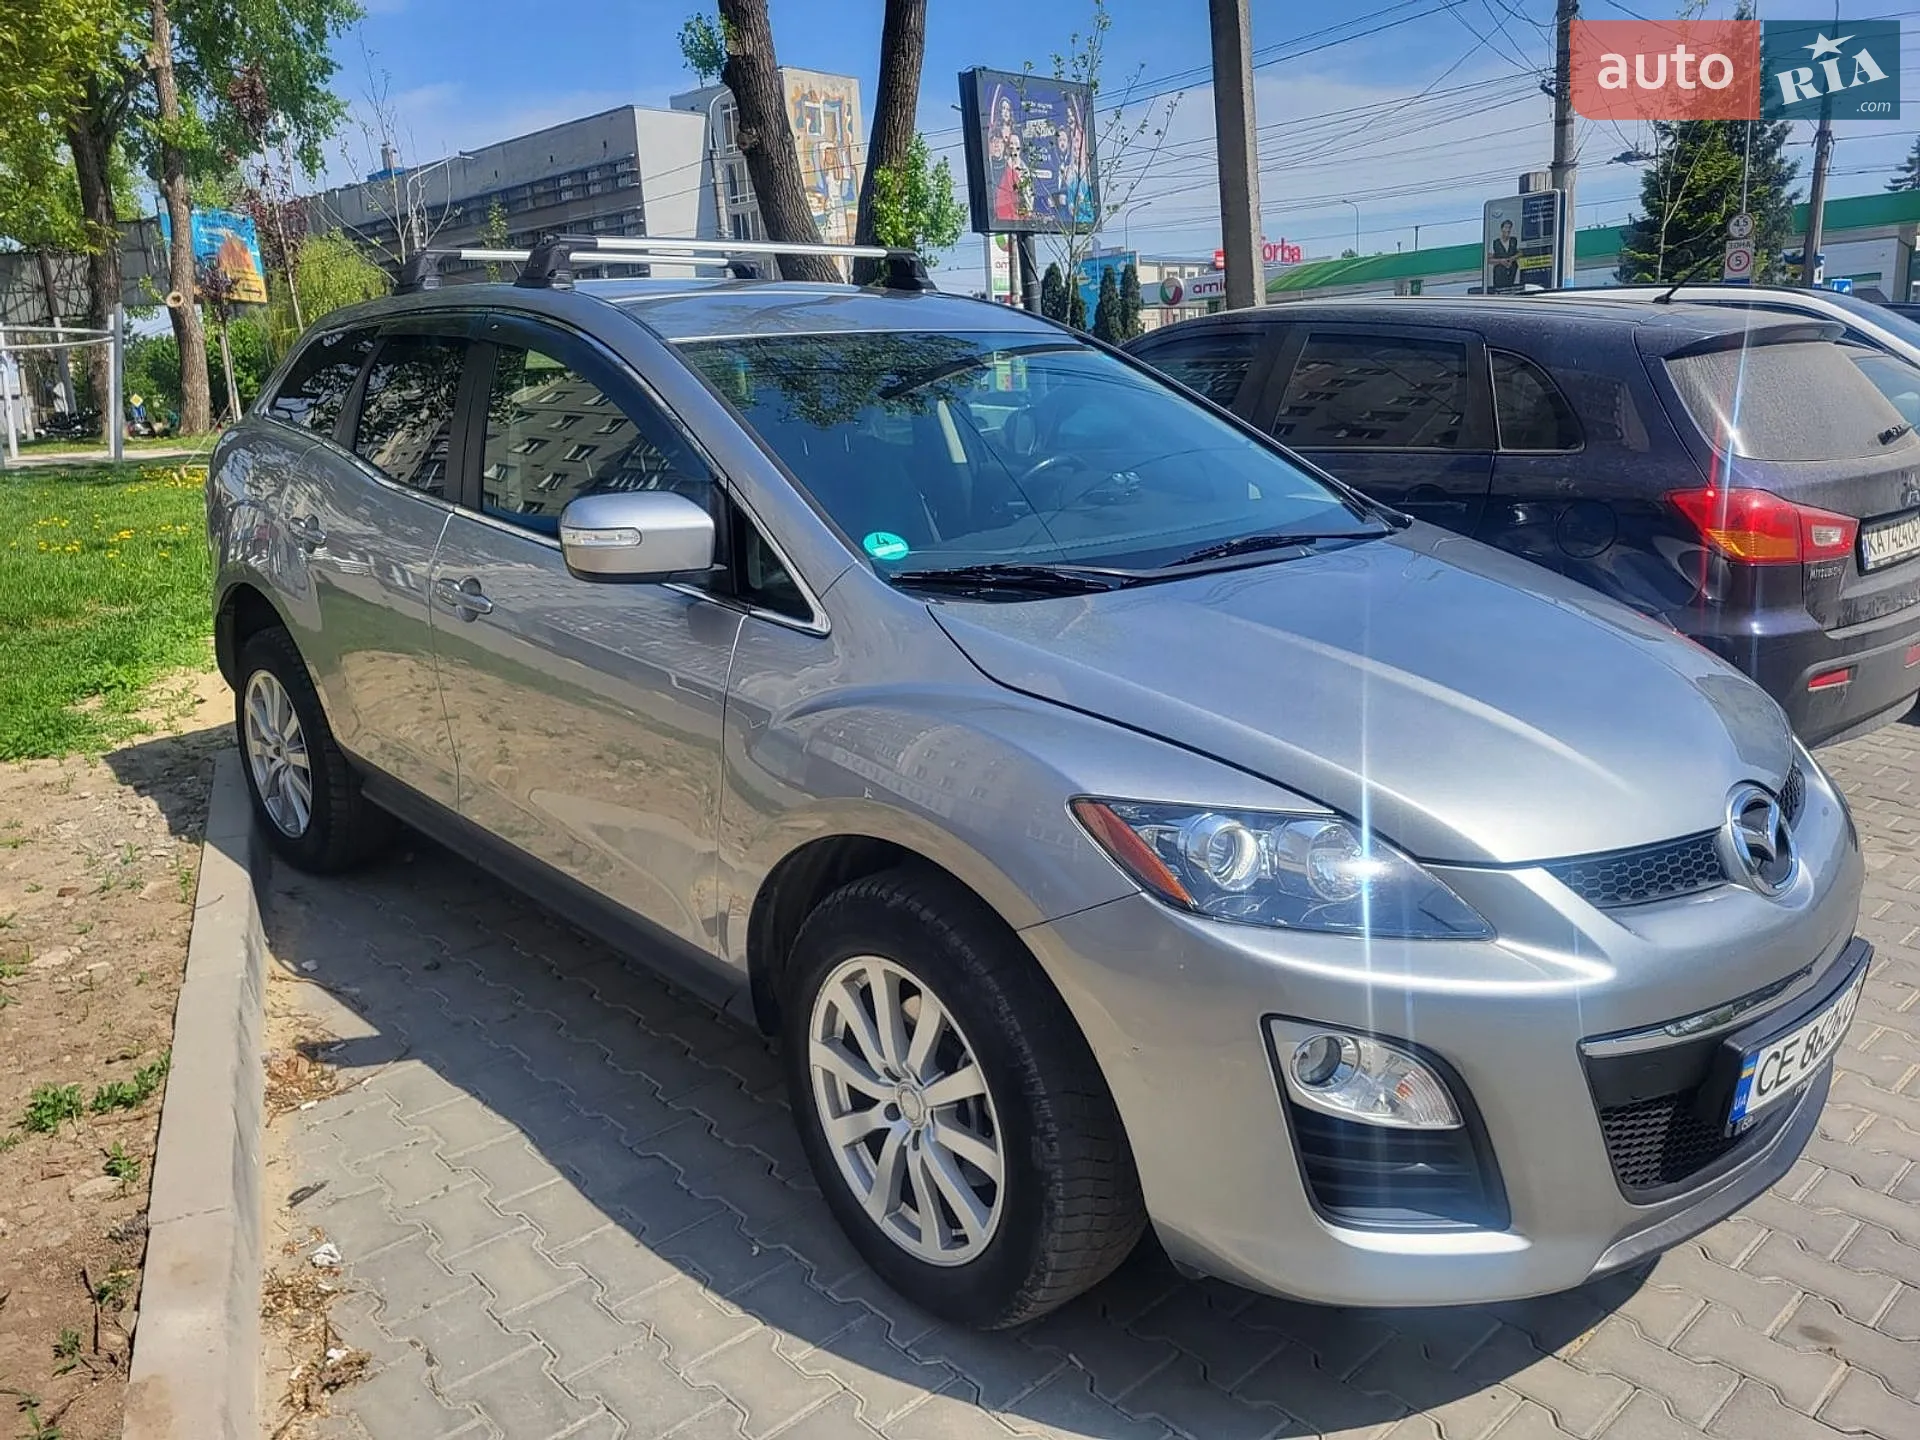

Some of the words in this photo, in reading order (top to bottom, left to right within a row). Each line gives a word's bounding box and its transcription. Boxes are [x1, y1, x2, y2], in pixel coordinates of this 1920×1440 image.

[1261, 237, 1303, 262] orba
[1735, 255, 1742, 267] 5
[1192, 279, 1225, 294] ami
[875, 533, 890, 546] 4
[1757, 1036, 1800, 1097] CE
